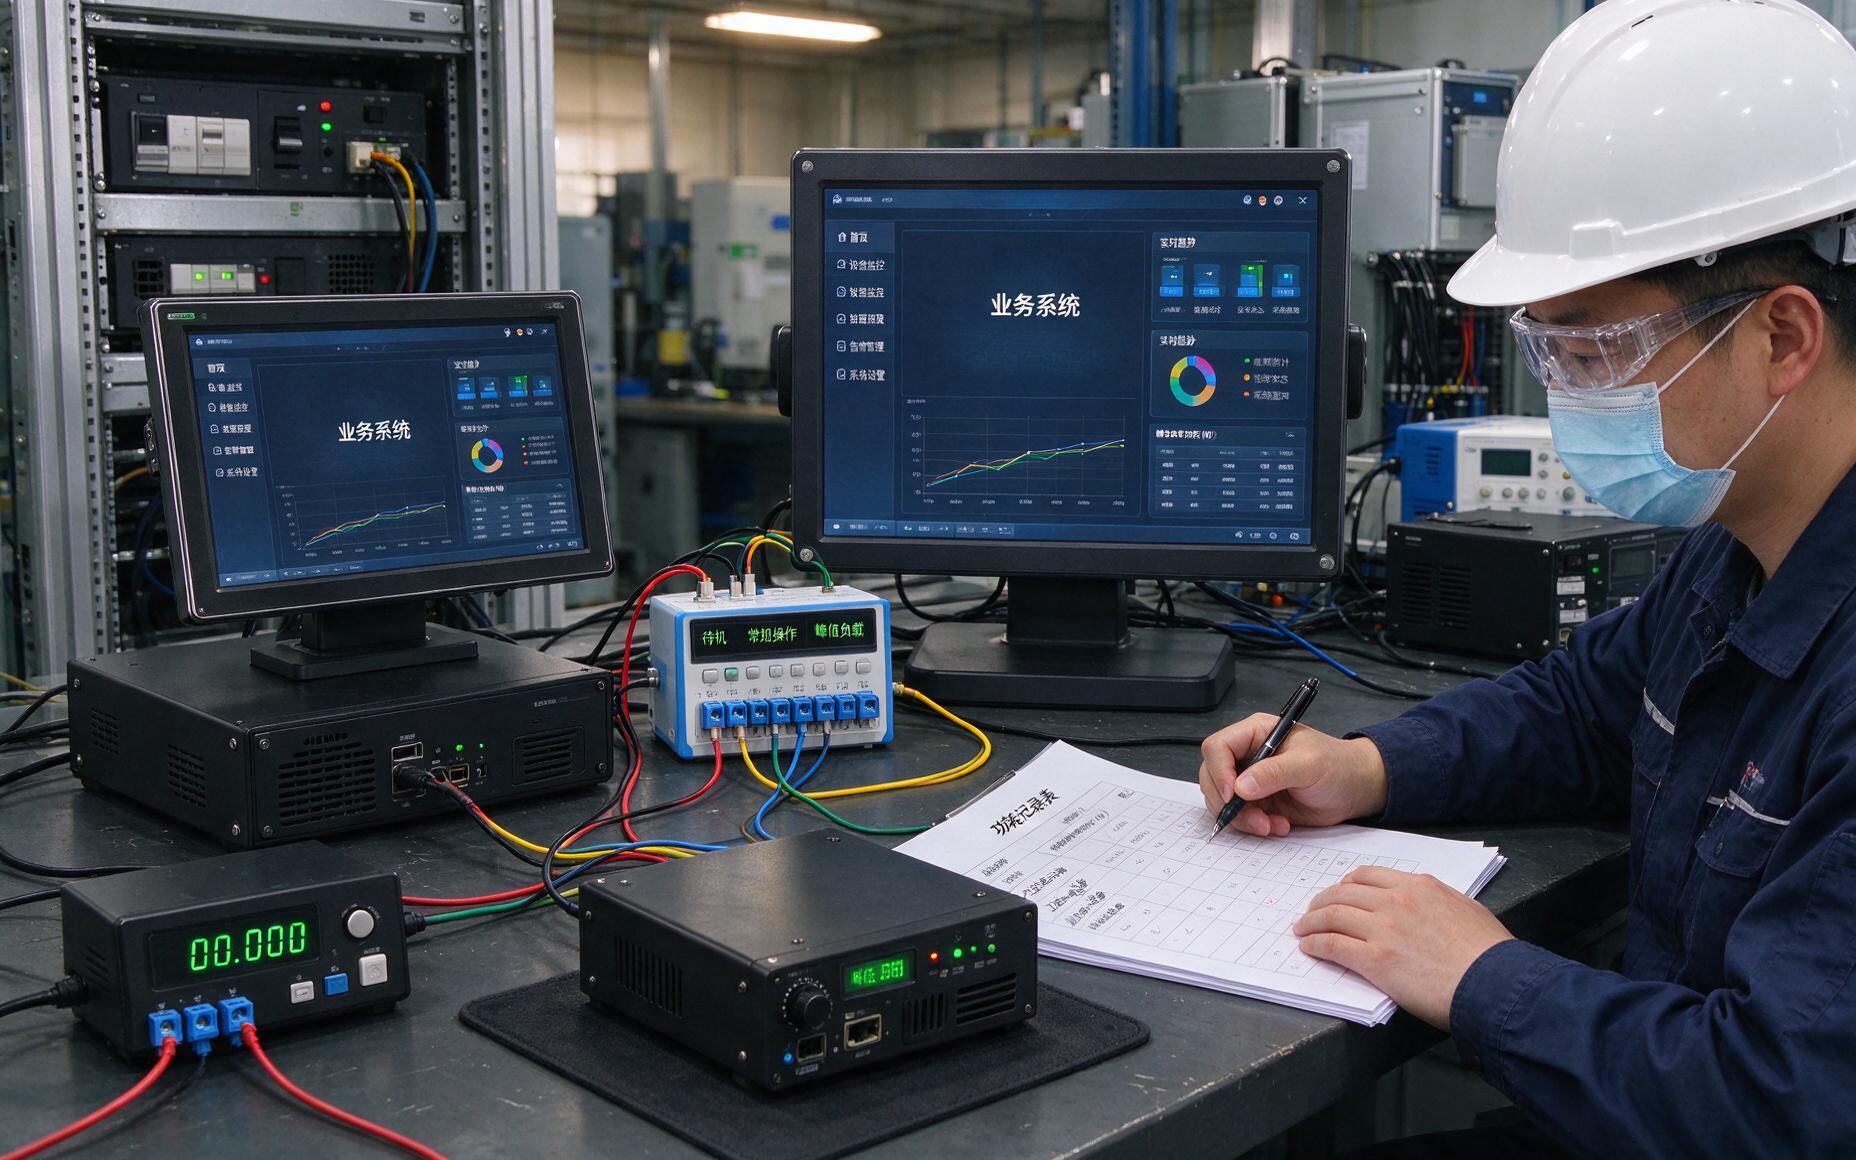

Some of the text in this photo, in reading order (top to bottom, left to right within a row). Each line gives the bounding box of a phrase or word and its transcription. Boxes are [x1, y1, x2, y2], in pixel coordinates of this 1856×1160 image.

[991, 292, 1081, 317] 业务系统
[338, 419, 412, 442] 业务系统
[702, 621, 865, 646] 待机 常规操作 峰值负载
[989, 788, 1060, 836] 功耗记录表
[190, 921, 306, 971] 00.000
